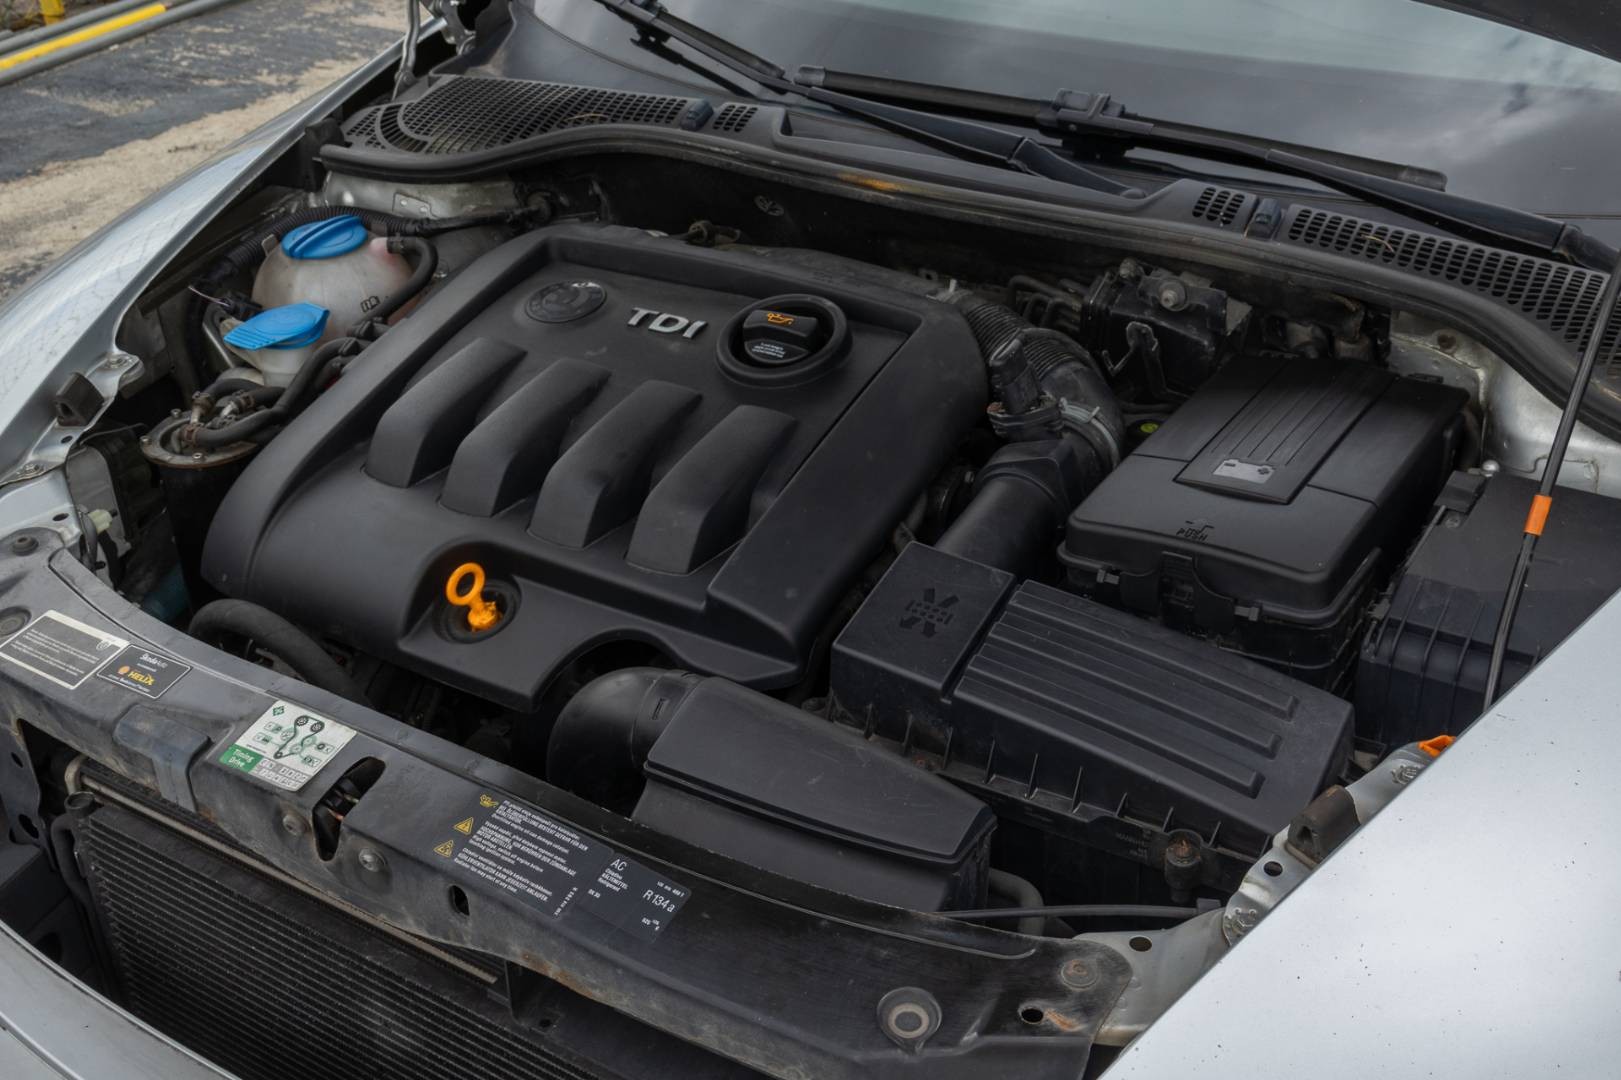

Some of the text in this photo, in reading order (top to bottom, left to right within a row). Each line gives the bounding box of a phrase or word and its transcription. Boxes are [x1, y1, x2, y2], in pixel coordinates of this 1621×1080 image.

[627, 306, 708, 339] TDI
[128, 671, 155, 686] HELIX
[610, 858, 627, 871] AC
[643, 889, 675, 912] R 134 a
